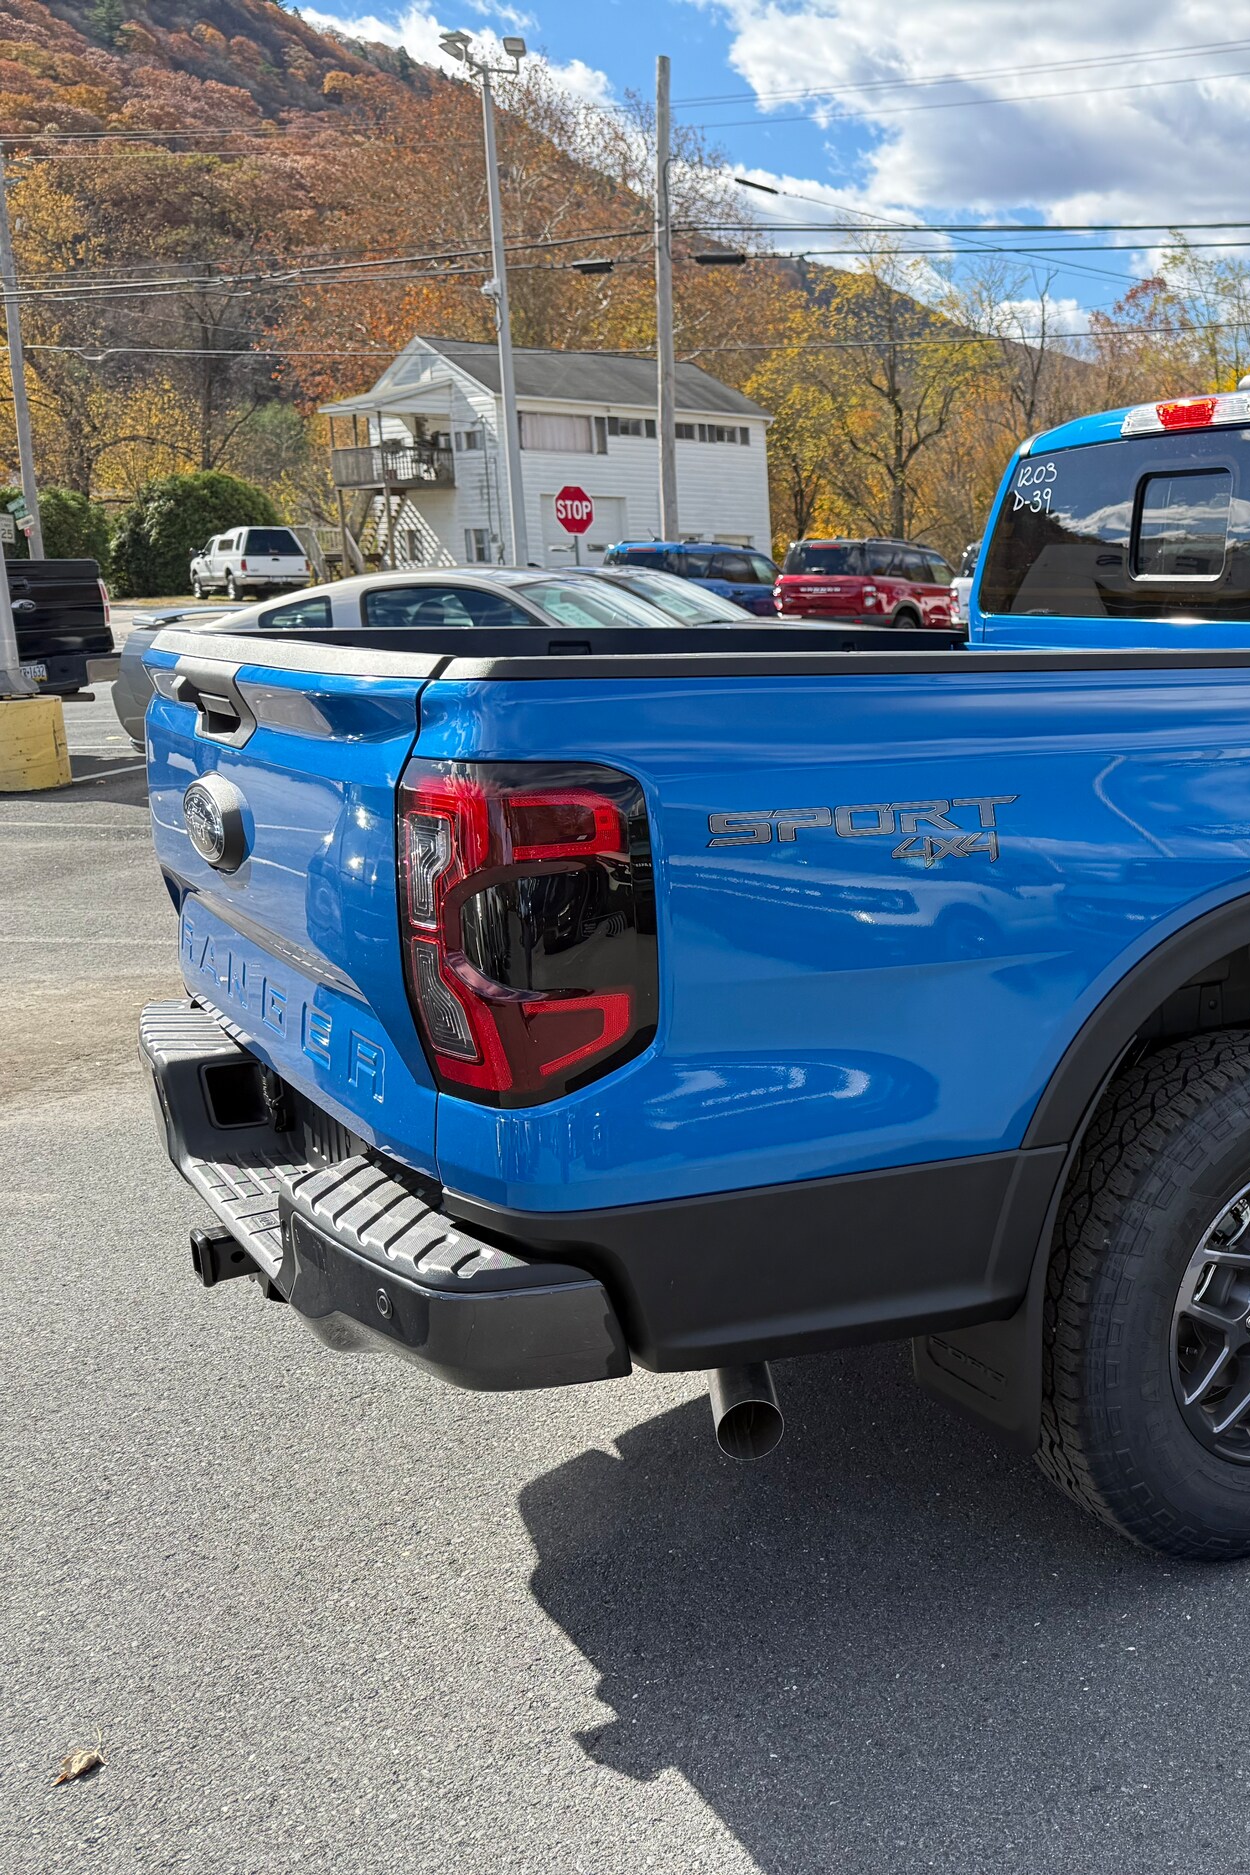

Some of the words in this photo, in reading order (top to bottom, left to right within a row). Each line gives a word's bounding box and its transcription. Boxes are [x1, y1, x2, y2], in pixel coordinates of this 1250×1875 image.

[1017, 462, 1057, 487] 1203
[557, 500, 591, 520] STOP
[1013, 488, 1052, 513] D-39
[706, 795, 1020, 848] SPORT
[182, 914, 385, 1104] RANGER
